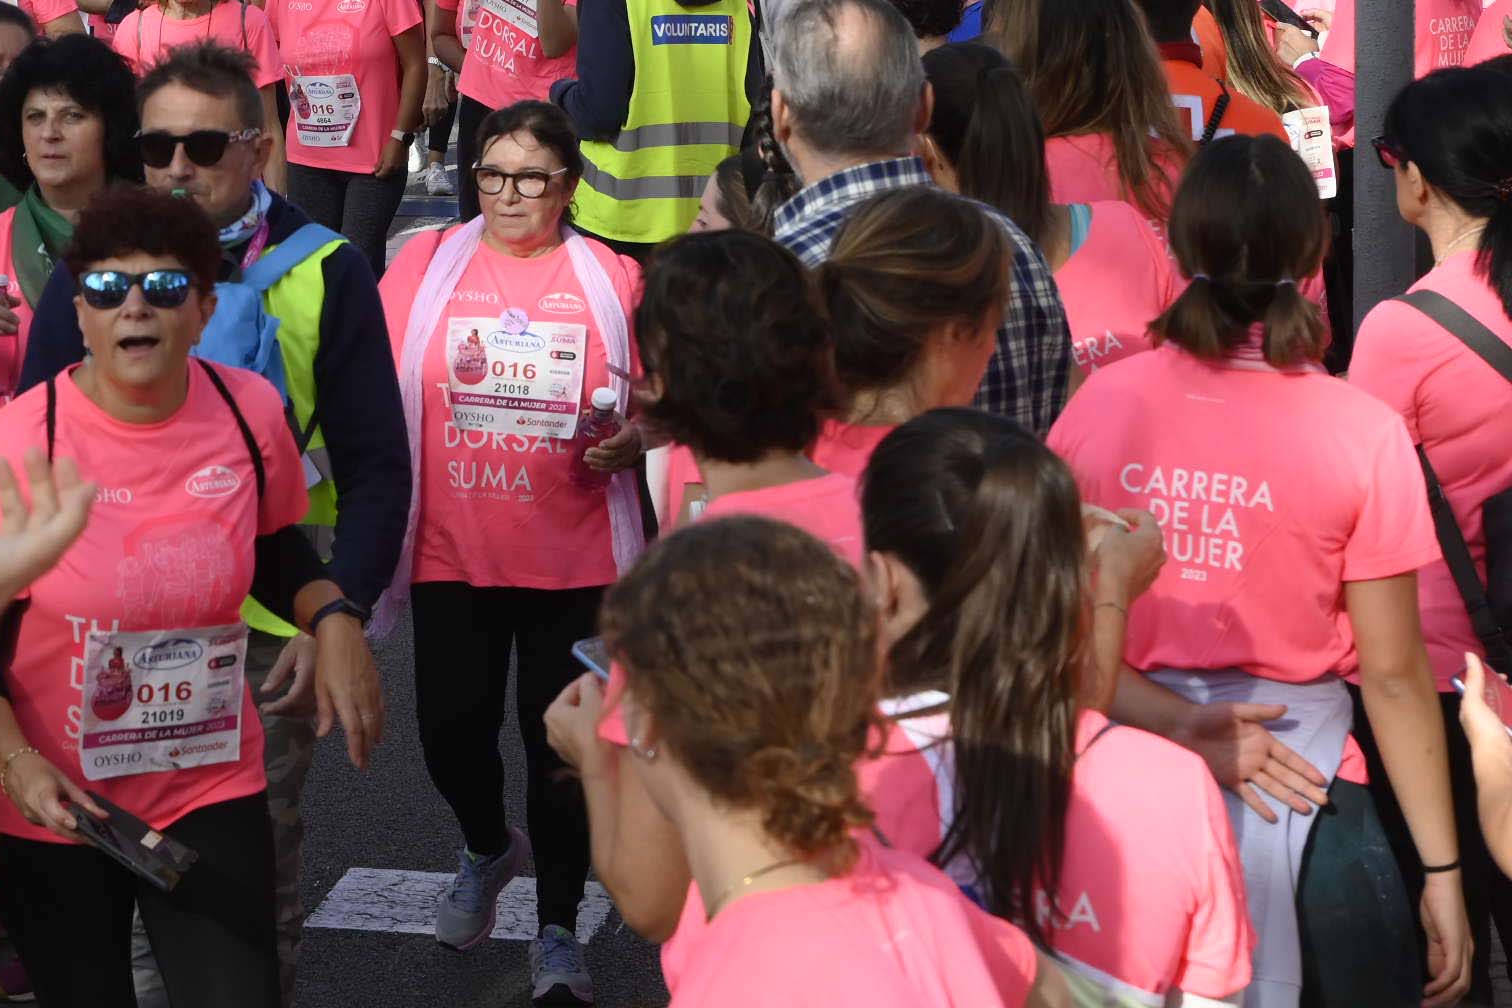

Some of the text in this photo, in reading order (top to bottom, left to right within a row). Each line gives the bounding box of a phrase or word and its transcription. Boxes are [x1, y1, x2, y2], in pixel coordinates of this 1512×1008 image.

[653, 21, 730, 39] VOLUNTARIS
[1429, 15, 1475, 36] CARRERA
[478, 11, 537, 59] DORSAL
[1440, 35, 1455, 50] DE
[475, 35, 516, 73] SUMA
[312, 104, 335, 115] 016
[491, 335, 543, 349] ASTURIANA
[492, 360, 537, 380] 016
[494, 382, 530, 396] 21018
[458, 395, 495, 406] CARRERA
[497, 398, 508, 407] DE
[509, 399, 519, 408] LA
[520, 400, 546, 410] MUJER
[454, 411, 495, 423] OYSHO
[527, 417, 568, 429] Santander
[447, 460, 533, 492] SUMA
[190, 477, 238, 493] ASTURIANA
[1119, 463, 1275, 513] CARRERA
[1200, 501, 1240, 539] LA
[1180, 567, 1208, 582] 2023
[137, 680, 193, 704] 016
[141, 708, 185, 725] 21019
[98, 733, 141, 744] CARRERA
[144, 731, 158, 740] DE
[159, 729, 172, 739] LA
[173, 725, 205, 736] MUJER
[180, 740, 228, 756] Santander
[93, 752, 142, 769] OYSHO
